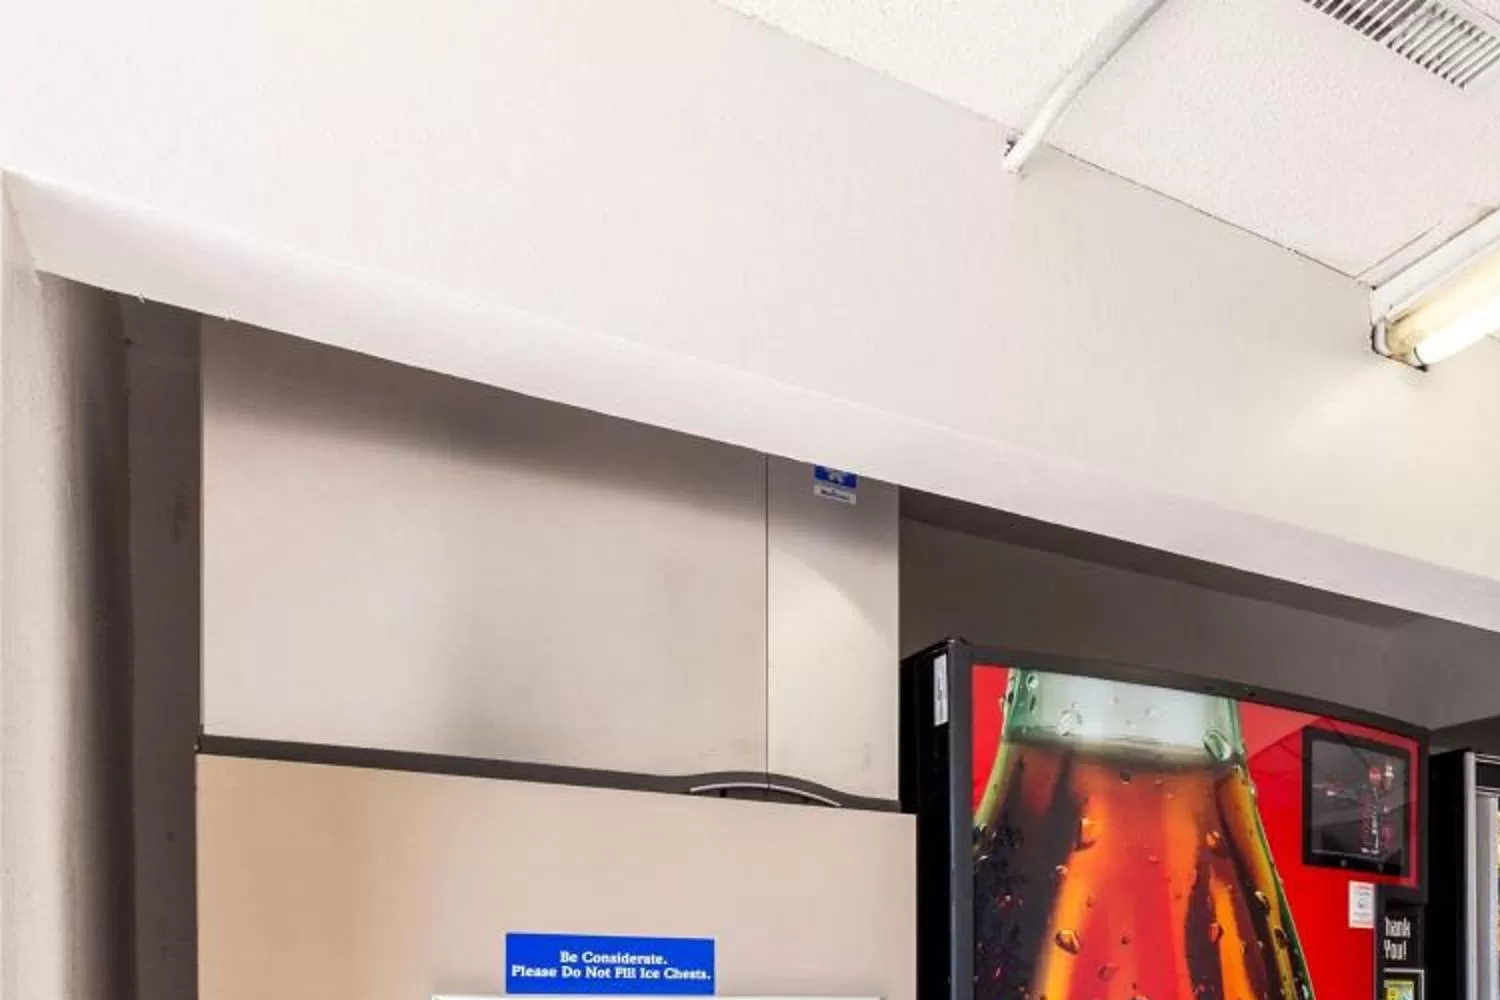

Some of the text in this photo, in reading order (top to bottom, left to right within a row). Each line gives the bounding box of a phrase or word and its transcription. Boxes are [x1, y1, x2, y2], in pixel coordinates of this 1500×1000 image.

[1384, 916, 1411, 938] hank
[560, 951, 668, 965] Be Considerate.
[1383, 939, 1407, 960] You!
[511, 965, 711, 980] Please Do Not Fill Ice Chests.
